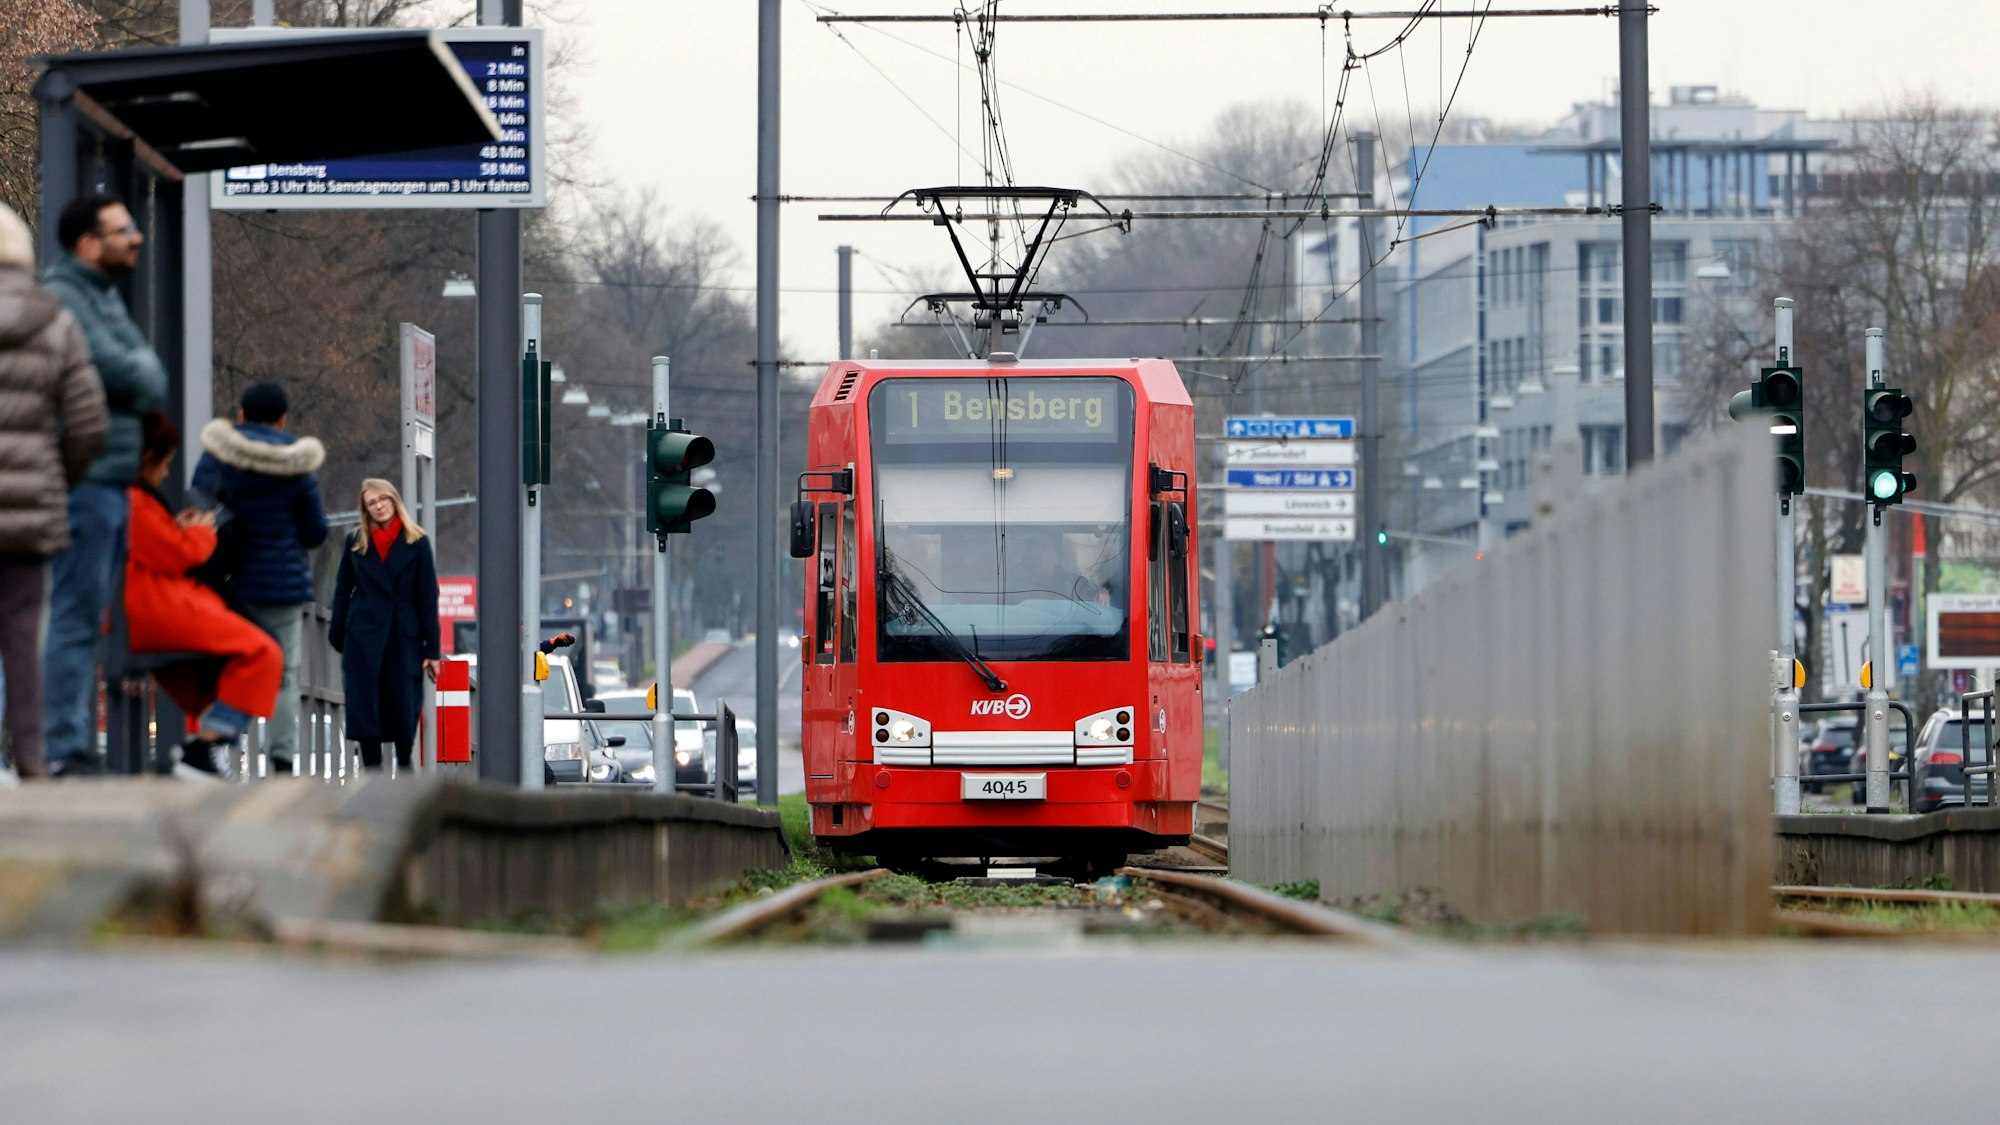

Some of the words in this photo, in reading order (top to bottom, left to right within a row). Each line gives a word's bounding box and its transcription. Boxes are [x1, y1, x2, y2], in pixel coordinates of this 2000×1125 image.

[512, 46, 525, 56] in
[487, 63, 498, 75] 2
[499, 62, 525, 75] Min
[487, 79, 498, 91] 8
[499, 79, 525, 92] Min
[499, 96, 525, 109] Min
[499, 112, 525, 125] Min
[500, 129, 525, 142] Min
[480, 145, 499, 159] 48
[499, 145, 525, 159] Min
[269, 164, 326, 177] Bensberg
[480, 162, 499, 175] 58
[499, 162, 525, 175] Min
[252, 180, 269, 193] ab
[271, 181, 279, 192] 3
[281, 180, 305, 193] Uhr
[307, 180, 327, 193] bis
[328, 180, 426, 194] Samstagmorgen
[428, 181, 450, 192] um
[452, 180, 460, 192] 3
[462, 179, 486, 192] Uhr
[487, 179, 529, 192] fahren
[908, 392, 918, 428] 1
[944, 391, 1102, 427] Bensberg
[971, 700, 1005, 715] KVB
[982, 781, 1027, 794] 4045
